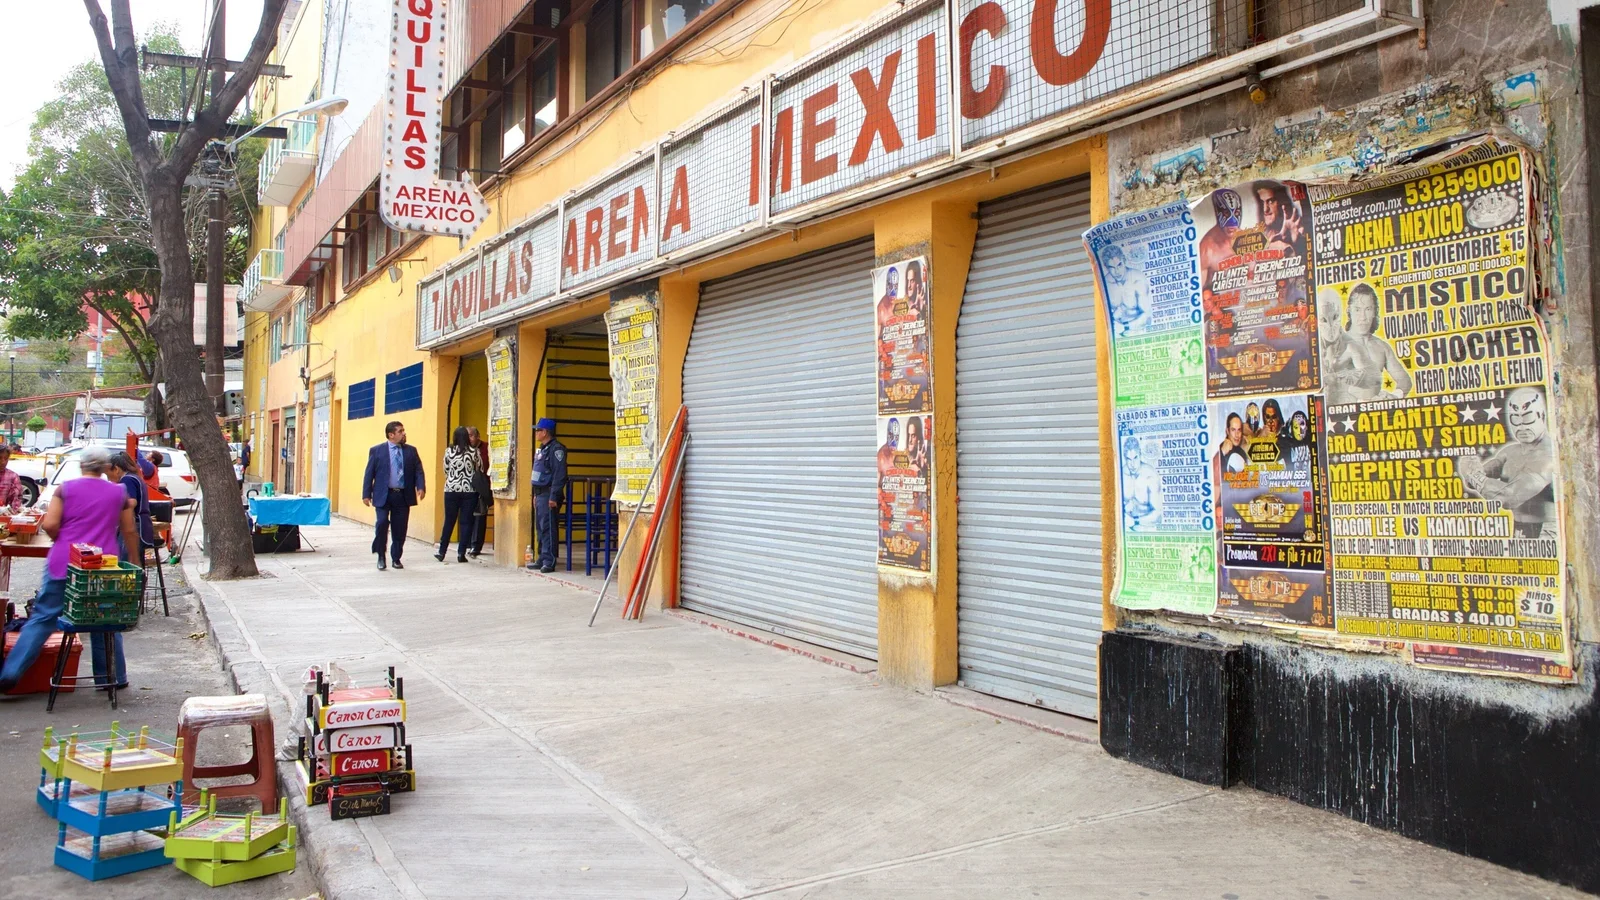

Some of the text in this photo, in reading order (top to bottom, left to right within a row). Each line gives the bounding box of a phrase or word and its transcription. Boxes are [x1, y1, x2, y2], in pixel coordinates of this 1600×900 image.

[562, 164, 692, 276] ARENA
[749, 0, 1112, 207] MEXICO
[396, 185, 472, 207] ARENA
[1341, 198, 1352, 207] en
[392, 202, 475, 223] MEXICO
[1313, 197, 1402, 226] icketmaster.com.mx
[1085, 220, 1123, 241] SABADOS
[1345, 202, 1464, 255] ARENA MEXICO
[1147, 234, 1184, 252] MISTICO
[1315, 229, 1341, 253] 8:30
[1144, 253, 1187, 270] DRAGON LEE
[1148, 245, 1186, 260] LA MASCARA
[1370, 257, 1386, 277] 27
[1390, 253, 1408, 273] DE
[1412, 236, 1501, 269] NOVIEMBRE
[1149, 270, 1189, 287] SHOCKER
[1211, 266, 1249, 282] ATLANTIS
[1253, 271, 1276, 284] BLACK
[1276, 265, 1306, 280] WARRIOR
[1389, 255, 1511, 285] ENCUENTRO ESTELAR DE IDOLOS
[1155, 282, 1183, 294] EUFORIA
[1384, 267, 1525, 313] MISTICO
[1308, 286, 1316, 332] LIBRE
[1384, 312, 1429, 340] VOLADOR
[1449, 307, 1456, 330] Y
[1459, 303, 1495, 328] SUPER
[1415, 326, 1541, 367] SHOCKER
[628, 354, 655, 368] MISTICO
[1311, 338, 1319, 385] ELITE
[1415, 357, 1543, 394] NEGRO CASAS Y EL FELINO
[1328, 391, 1495, 415] GRAN SEMIFINAL DE ALARIDO
[1117, 410, 1148, 421] SABADOS
[1172, 407, 1181, 416] DE
[1183, 404, 1207, 414] ARENA
[1358, 404, 1458, 433] ATLANTIS
[1162, 438, 1196, 449] MISTICO
[1367, 430, 1418, 451] MAYA
[1422, 428, 1434, 448] Y
[1440, 423, 1506, 447] STUKA
[1158, 457, 1199, 467] DRAGON LEE
[1162, 448, 1198, 458] LA MASCARA
[1340, 446, 1476, 463] CONTRA CONTRA CONTRA
[1269, 470, 1307, 480] DAMIAN 666
[1311, 448, 1319, 490] LIBRE
[1162, 475, 1201, 485] SHOCKER
[1330, 477, 1463, 500] UCIFERNO Y EPHESTO
[1164, 494, 1186, 502] ULTIMO
[1167, 485, 1195, 494] EUFORIA
[1320, 467, 1328, 515] LUCHA
[1354, 503, 1389, 515] ESPECIAL
[1391, 502, 1401, 515] EN
[1403, 502, 1431, 514] MATCH
[1433, 501, 1484, 514] RELAMPAGO
[1333, 516, 1510, 537] RAGON LEE VS KAMAITACHI
[1348, 538, 1356, 554] DE
[1226, 544, 1258, 561] Promoción
[1300, 550, 1306, 567] 7
[1307, 550, 1312, 563] a
[1313, 549, 1322, 563] 12
[1356, 571, 1361, 580] Y
[1363, 571, 1386, 580] ROBIN
[1390, 571, 1420, 583] CONTRA
[1425, 573, 1444, 583] HIJO
[1446, 573, 1461, 584] DEL
[1464, 574, 1490, 585] SIGNO
[1492, 575, 1498, 585] Y
[1501, 575, 1540, 587] ESPANTO
[1543, 577, 1559, 588] JR.
[1472, 587, 1514, 601] 100.00
[1478, 600, 1515, 614] 90.00
[1536, 601, 1554, 615] 10
[1392, 607, 1450, 622] GRADAS
[1469, 612, 1516, 627] 40.00
[327, 708, 401, 725] Canon Canon
[337, 733, 382, 749] Canon
[341, 757, 380, 772] Canon
